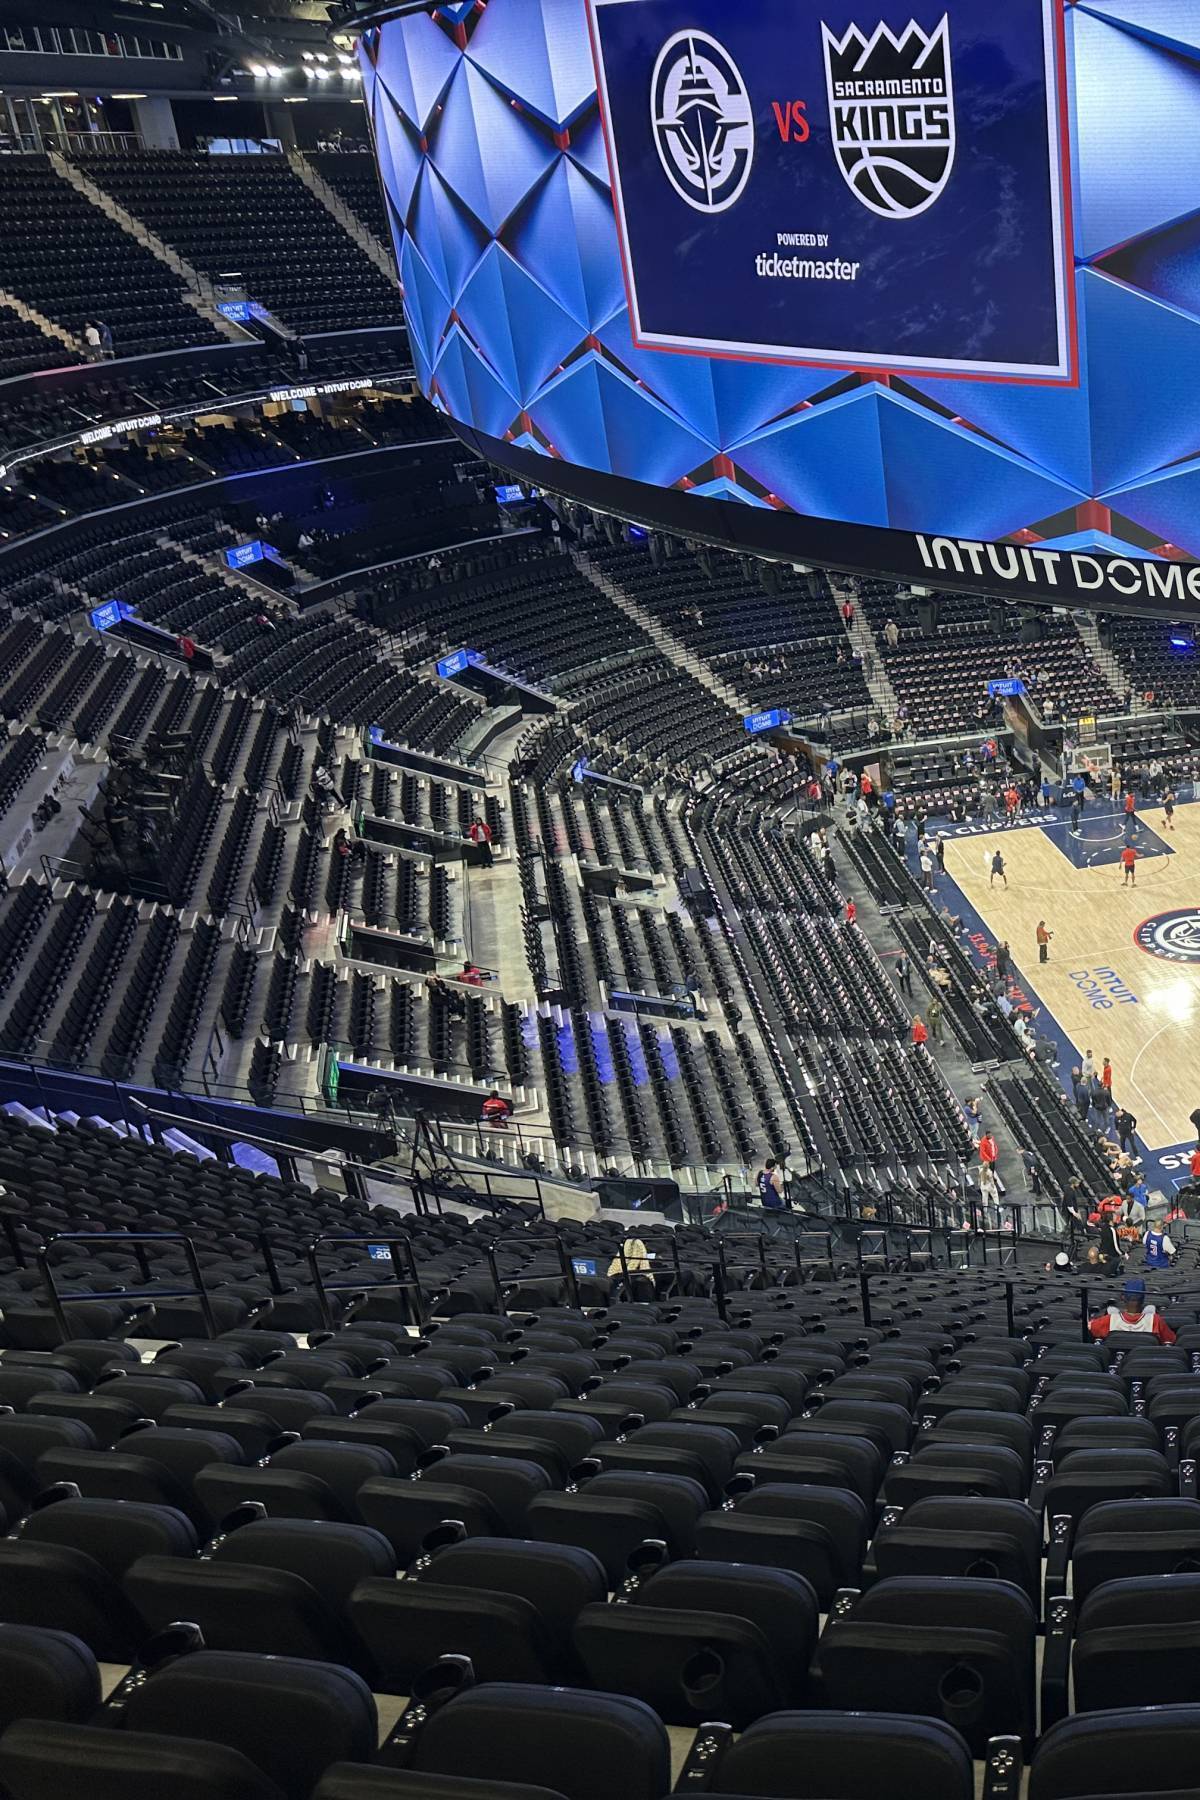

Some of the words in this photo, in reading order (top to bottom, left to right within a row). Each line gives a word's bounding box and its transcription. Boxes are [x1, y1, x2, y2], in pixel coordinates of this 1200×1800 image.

[835, 78, 943, 97] SACRAMENTO
[772, 101, 811, 142] VS
[836, 104, 950, 142] KINGS
[777, 233, 816, 247] POWERED
[817, 234, 828, 247] BY
[755, 253, 860, 281] ticketmaster
[270, 386, 317, 402] WELCOME
[80, 425, 113, 445] WELCOME
[924, 830, 952, 840] LA
[955, 815, 1058, 835] CLIPERS
[1140, 922, 1188, 961] CLIPPERS
[376, 1251, 391, 1260] 20
[574, 1265, 587, 1274] 19
